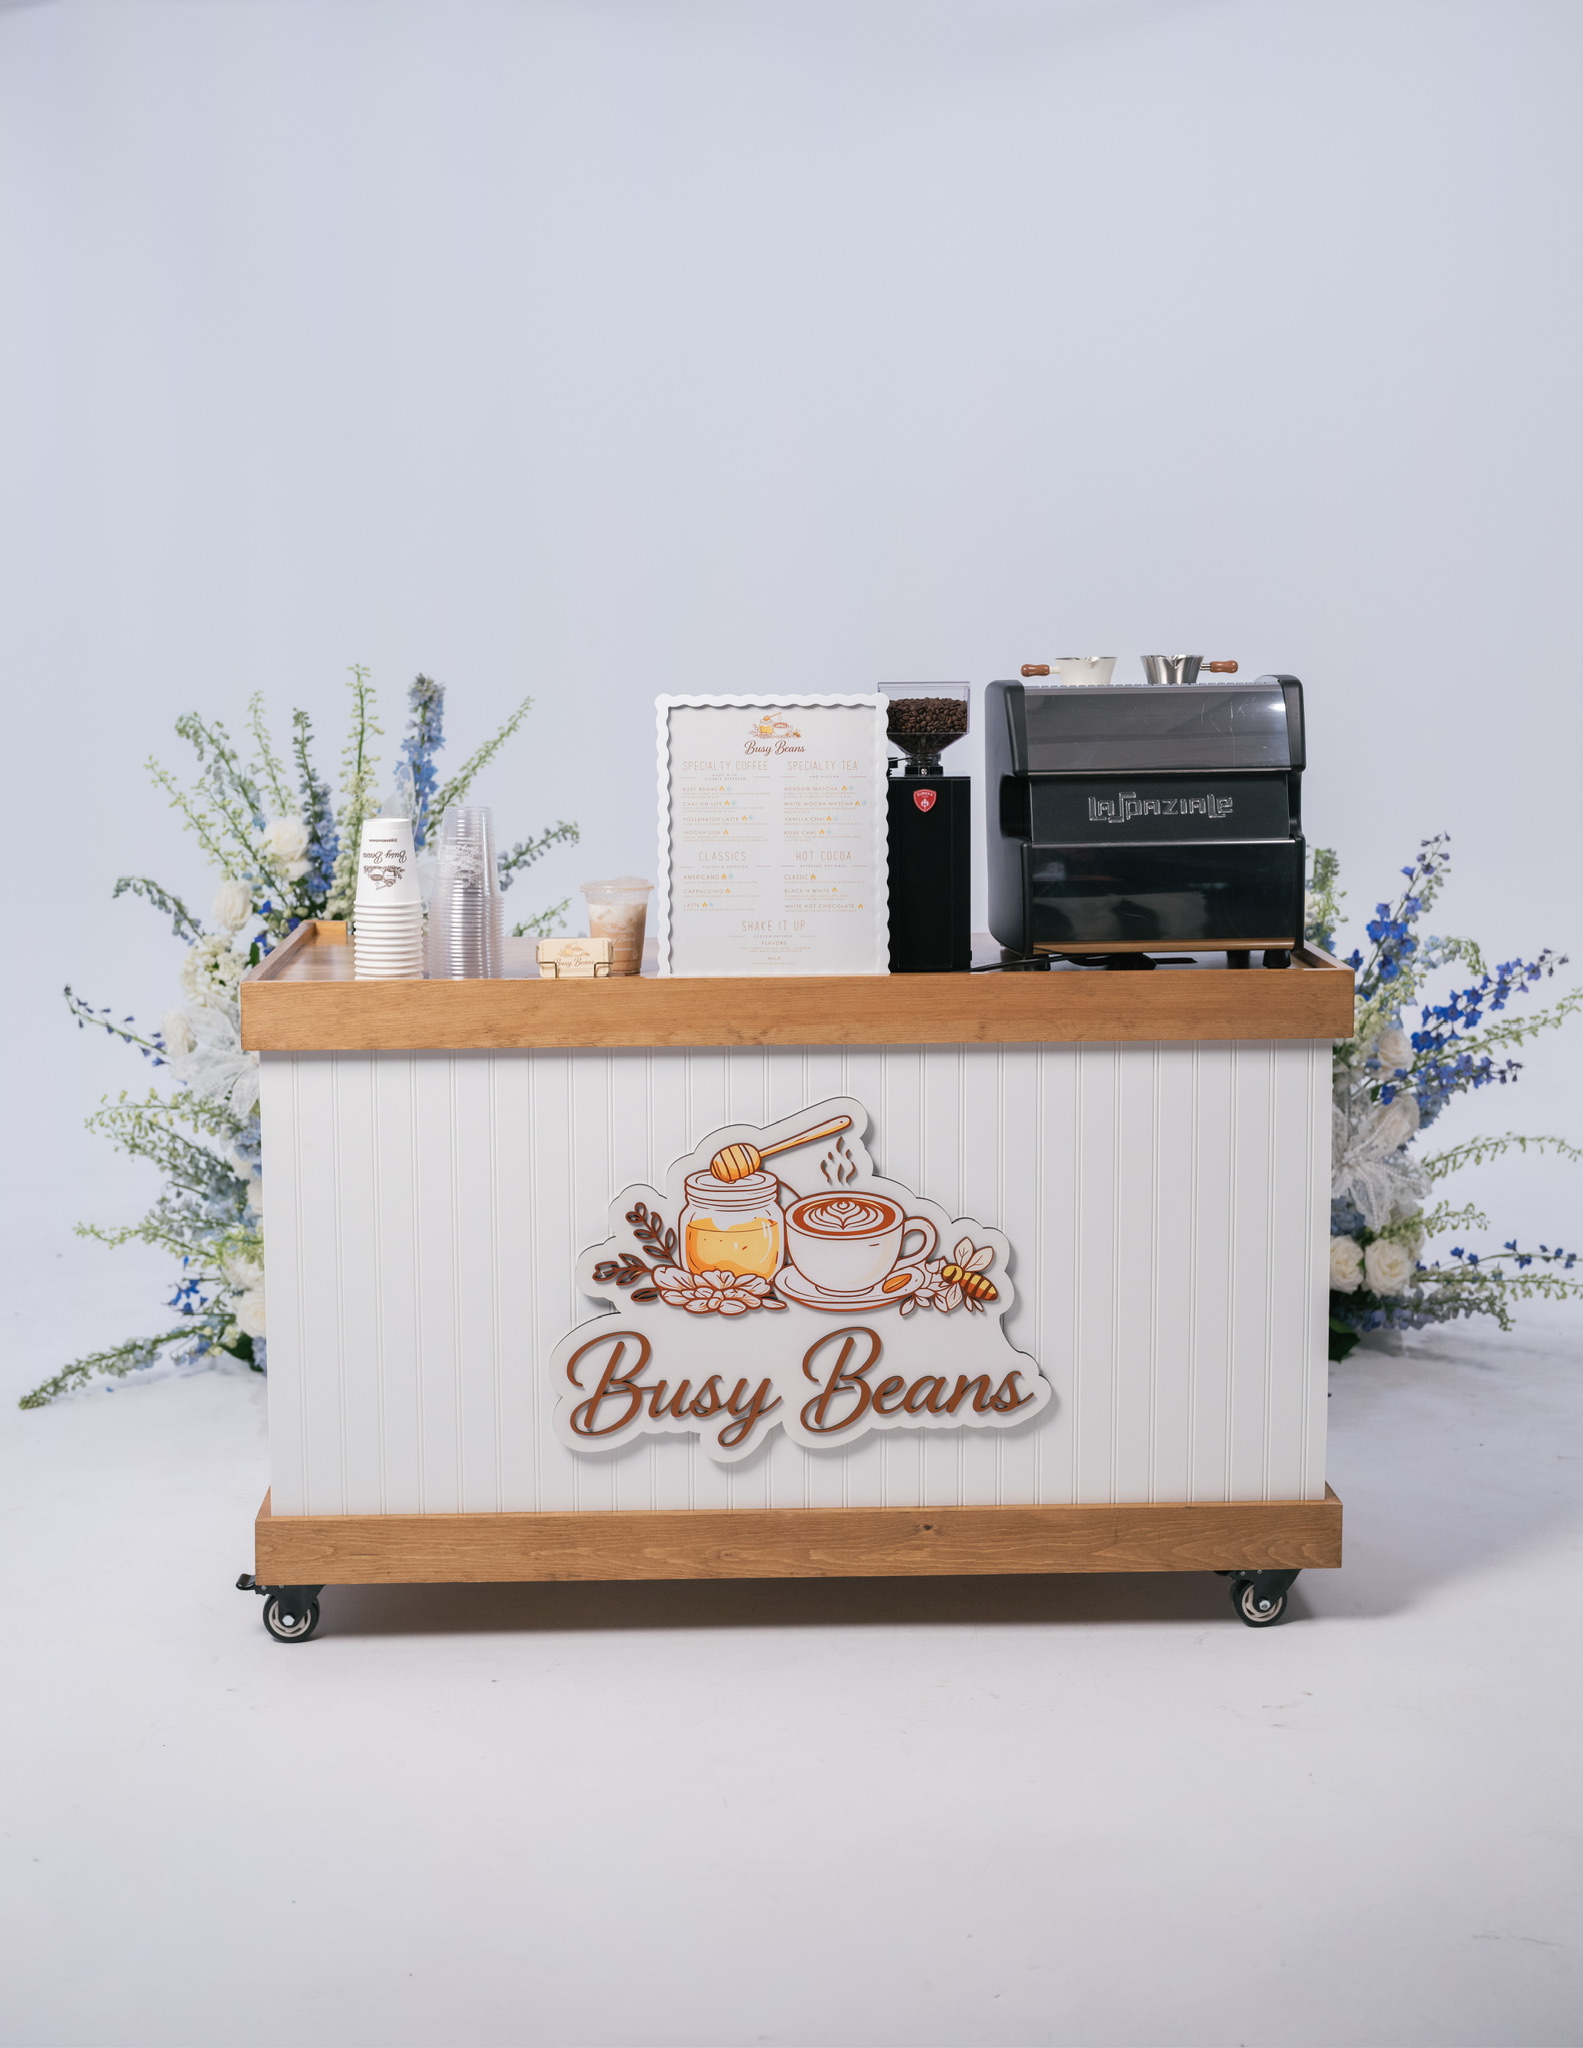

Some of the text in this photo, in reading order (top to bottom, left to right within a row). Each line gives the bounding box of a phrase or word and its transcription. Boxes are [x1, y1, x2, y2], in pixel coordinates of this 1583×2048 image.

[744, 739, 806, 757] Busy Beans
[682, 760, 769, 771] SPECIALTY COFFEE
[787, 760, 858, 771] SPECIALTY TEA
[385, 849, 408, 864] Busy
[698, 851, 747, 862] CLASSICS
[795, 851, 852, 861] HOT COCOA
[741, 920, 806, 932] SHAKE IT UP
[574, 957, 595, 967] Beans
[566, 1326, 1035, 1448] Busy Beans
